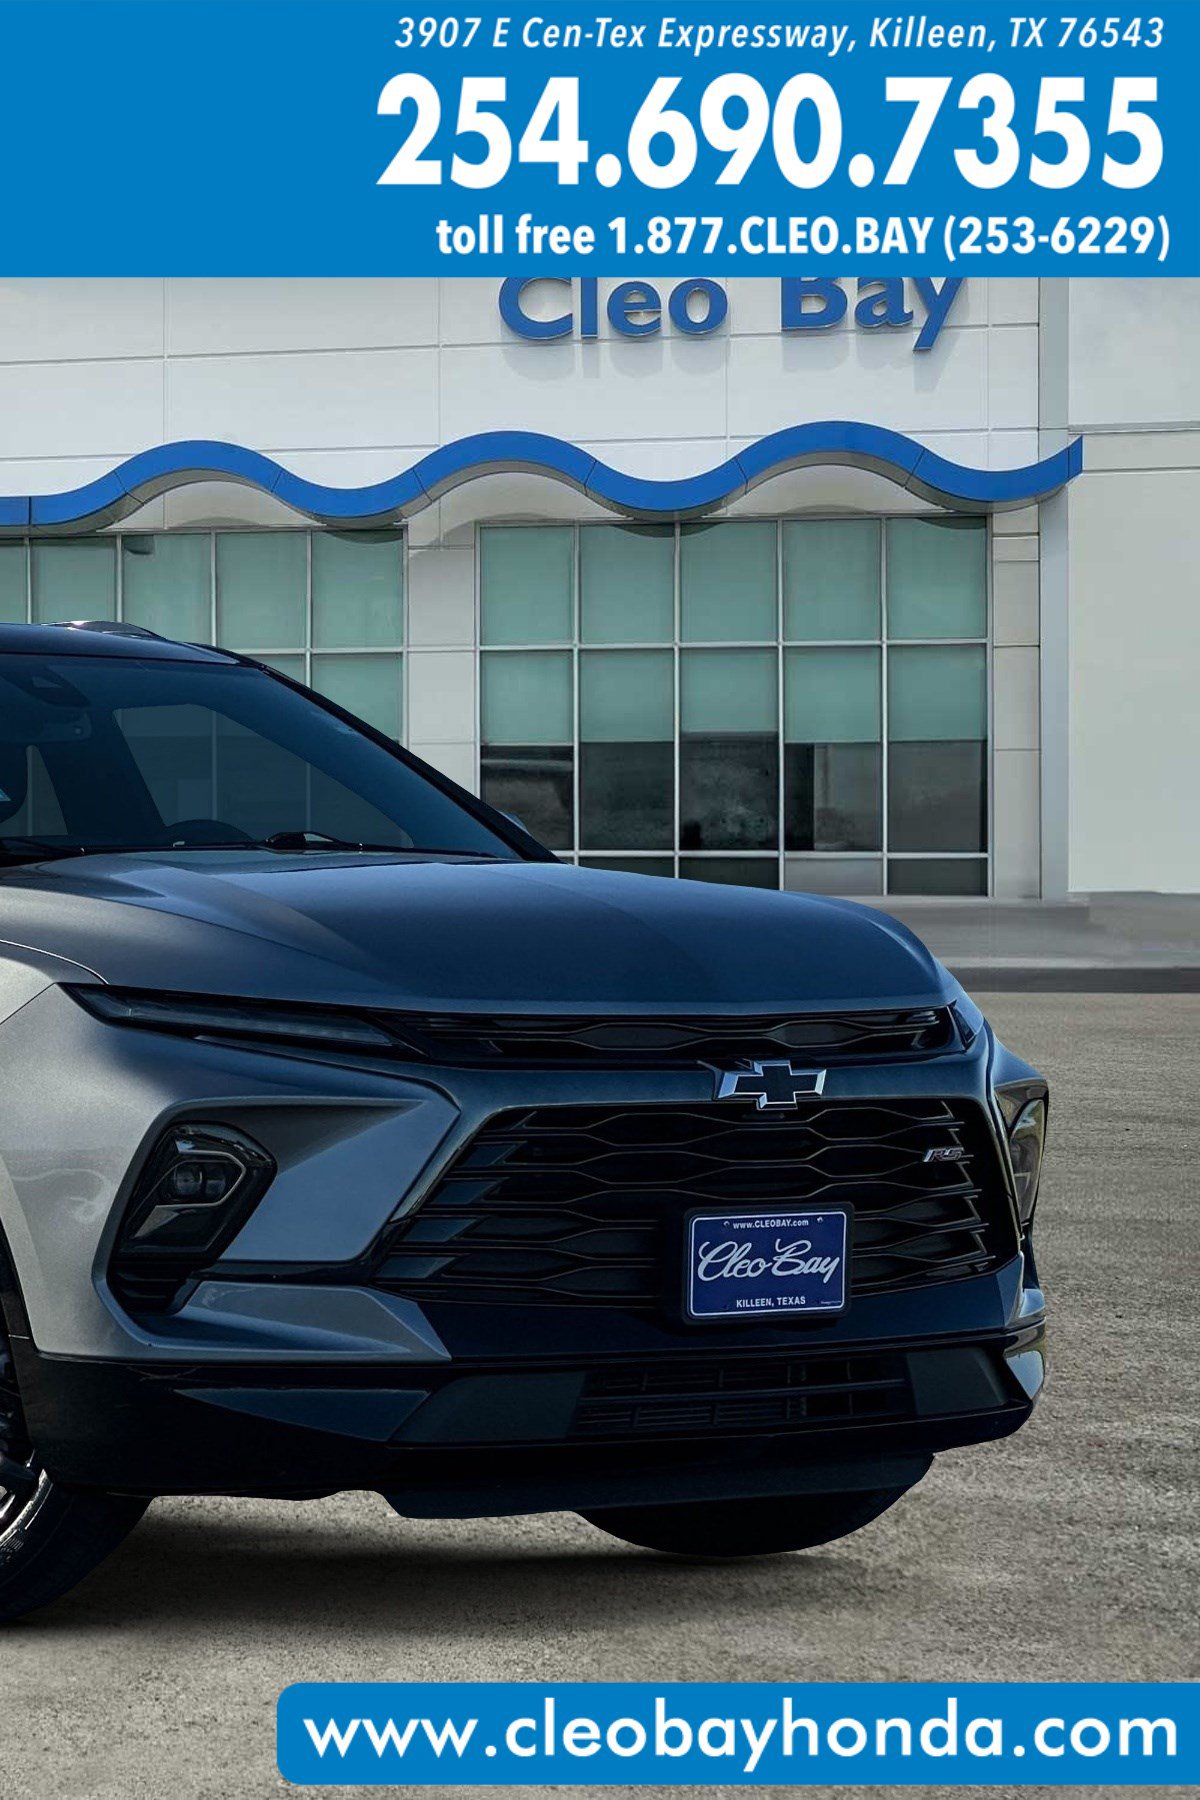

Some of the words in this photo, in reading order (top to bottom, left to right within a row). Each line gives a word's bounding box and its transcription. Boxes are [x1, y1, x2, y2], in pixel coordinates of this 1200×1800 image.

[498, 277, 728, 341] Cleo
[781, 277, 966, 351] Bay
[732, 1218, 809, 1230] www.CLEOBAY.com
[697, 1240, 773, 1282] Cleo
[771, 1238, 841, 1284] Bay
[735, 1297, 776, 1309] KILLEEN,
[776, 1296, 806, 1307] TEXAS
